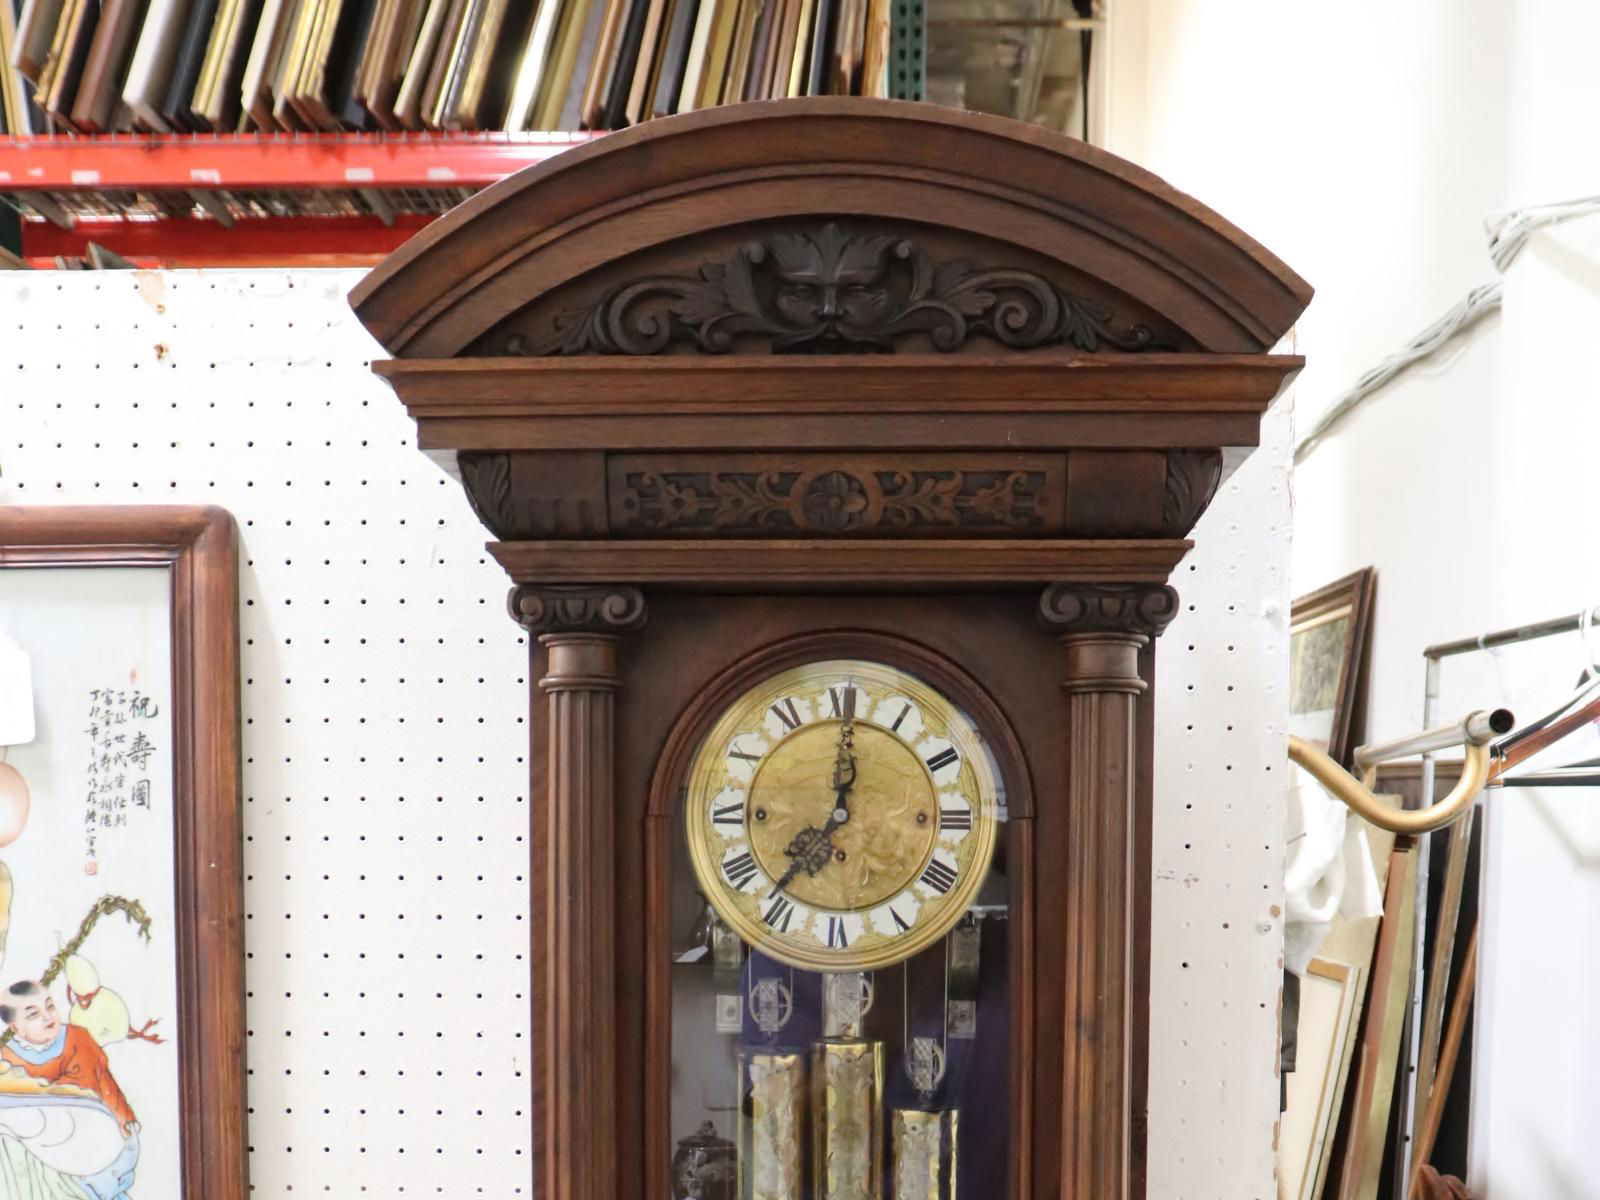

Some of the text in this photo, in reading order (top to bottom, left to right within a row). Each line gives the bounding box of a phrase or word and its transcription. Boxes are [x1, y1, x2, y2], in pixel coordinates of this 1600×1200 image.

[771, 697, 802, 730] XI
[891, 703, 911, 731] I
[126, 690, 159, 810] 祝壽圖
[729, 741, 759, 769] X
[926, 747, 958, 772] II
[713, 802, 744, 824] IX
[941, 810, 971, 830] III
[721, 853, 758, 891] VIII
[920, 858, 958, 895] IIII
[763, 896, 794, 932] VII
